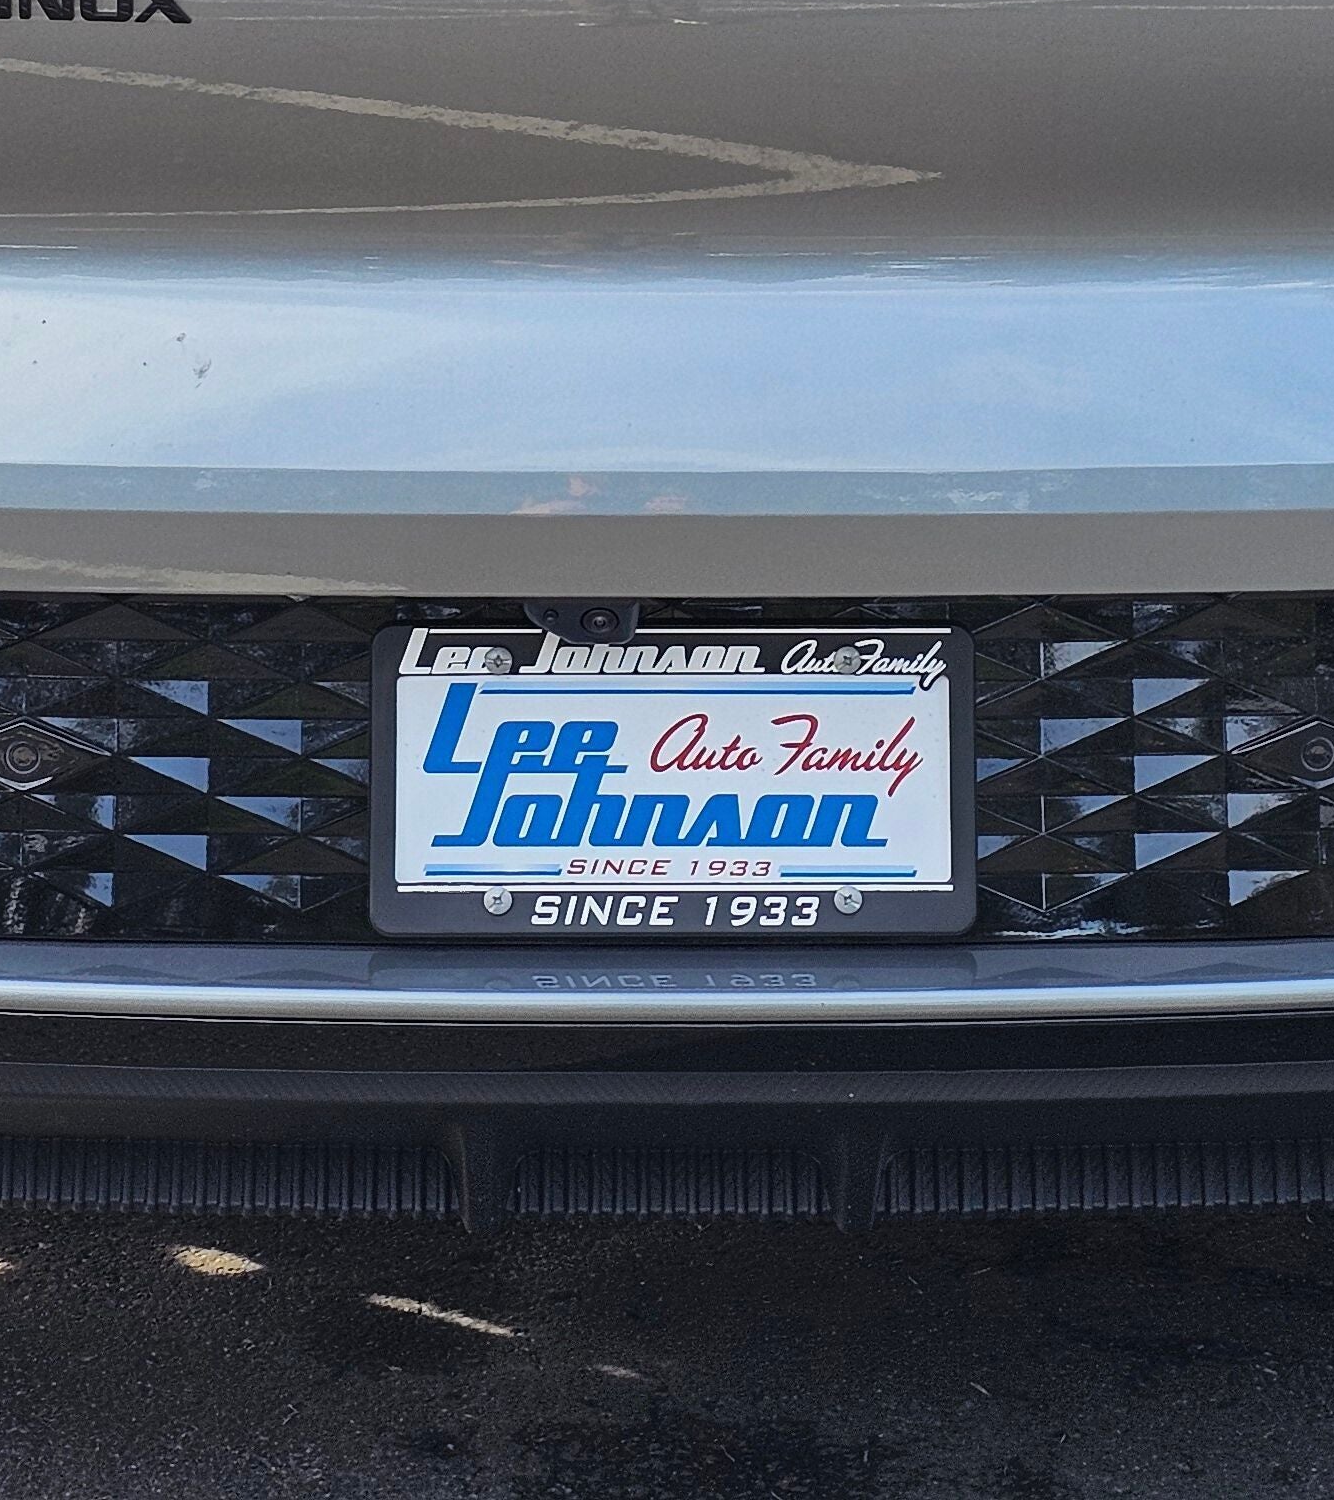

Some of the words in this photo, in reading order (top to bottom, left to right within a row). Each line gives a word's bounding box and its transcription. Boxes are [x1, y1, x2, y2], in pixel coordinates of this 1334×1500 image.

[518, 629, 766, 674] Johnson
[780, 639, 860, 675] Aut
[854, 638, 948, 688] Family
[422, 682, 629, 774] Lee
[649, 713, 764, 773] Auto
[770, 713, 924, 798] Family
[430, 756, 889, 848] Johnson
[566, 858, 672, 876] SINCE
[689, 859, 773, 878] 1933
[530, 894, 680, 927] SINCE
[703, 895, 821, 928] 1933
